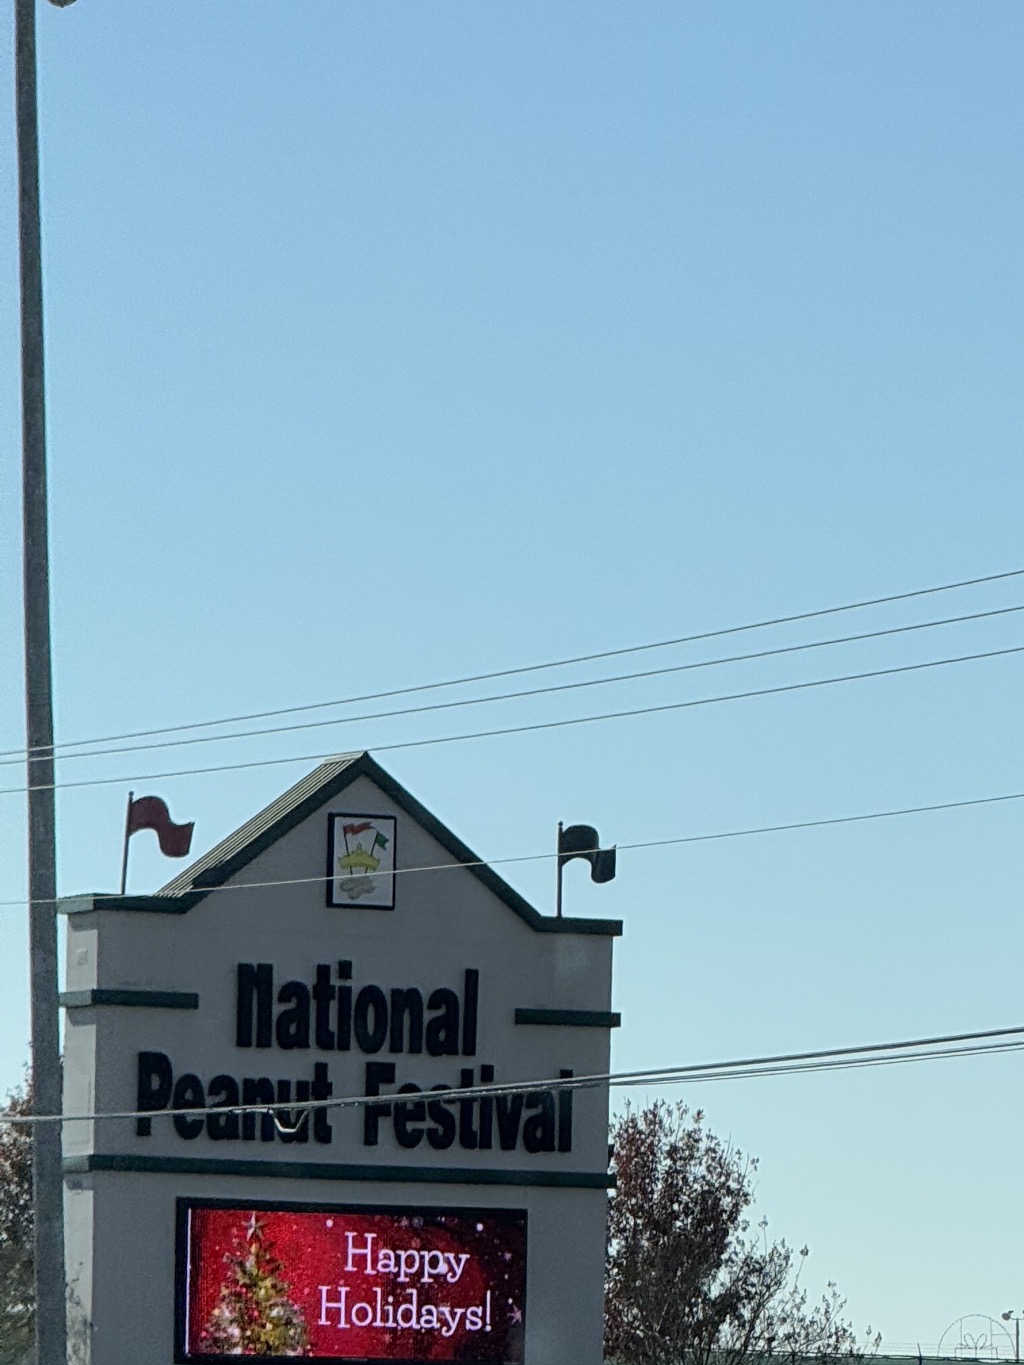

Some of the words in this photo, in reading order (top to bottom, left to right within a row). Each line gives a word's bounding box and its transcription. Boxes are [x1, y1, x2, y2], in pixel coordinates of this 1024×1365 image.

[236, 960, 479, 1057] National
[137, 1051, 333, 1144] Peanut
[364, 1061, 574, 1153] Festival
[344, 1231, 471, 1284] Happy
[318, 1285, 492, 1338] Holidays!
